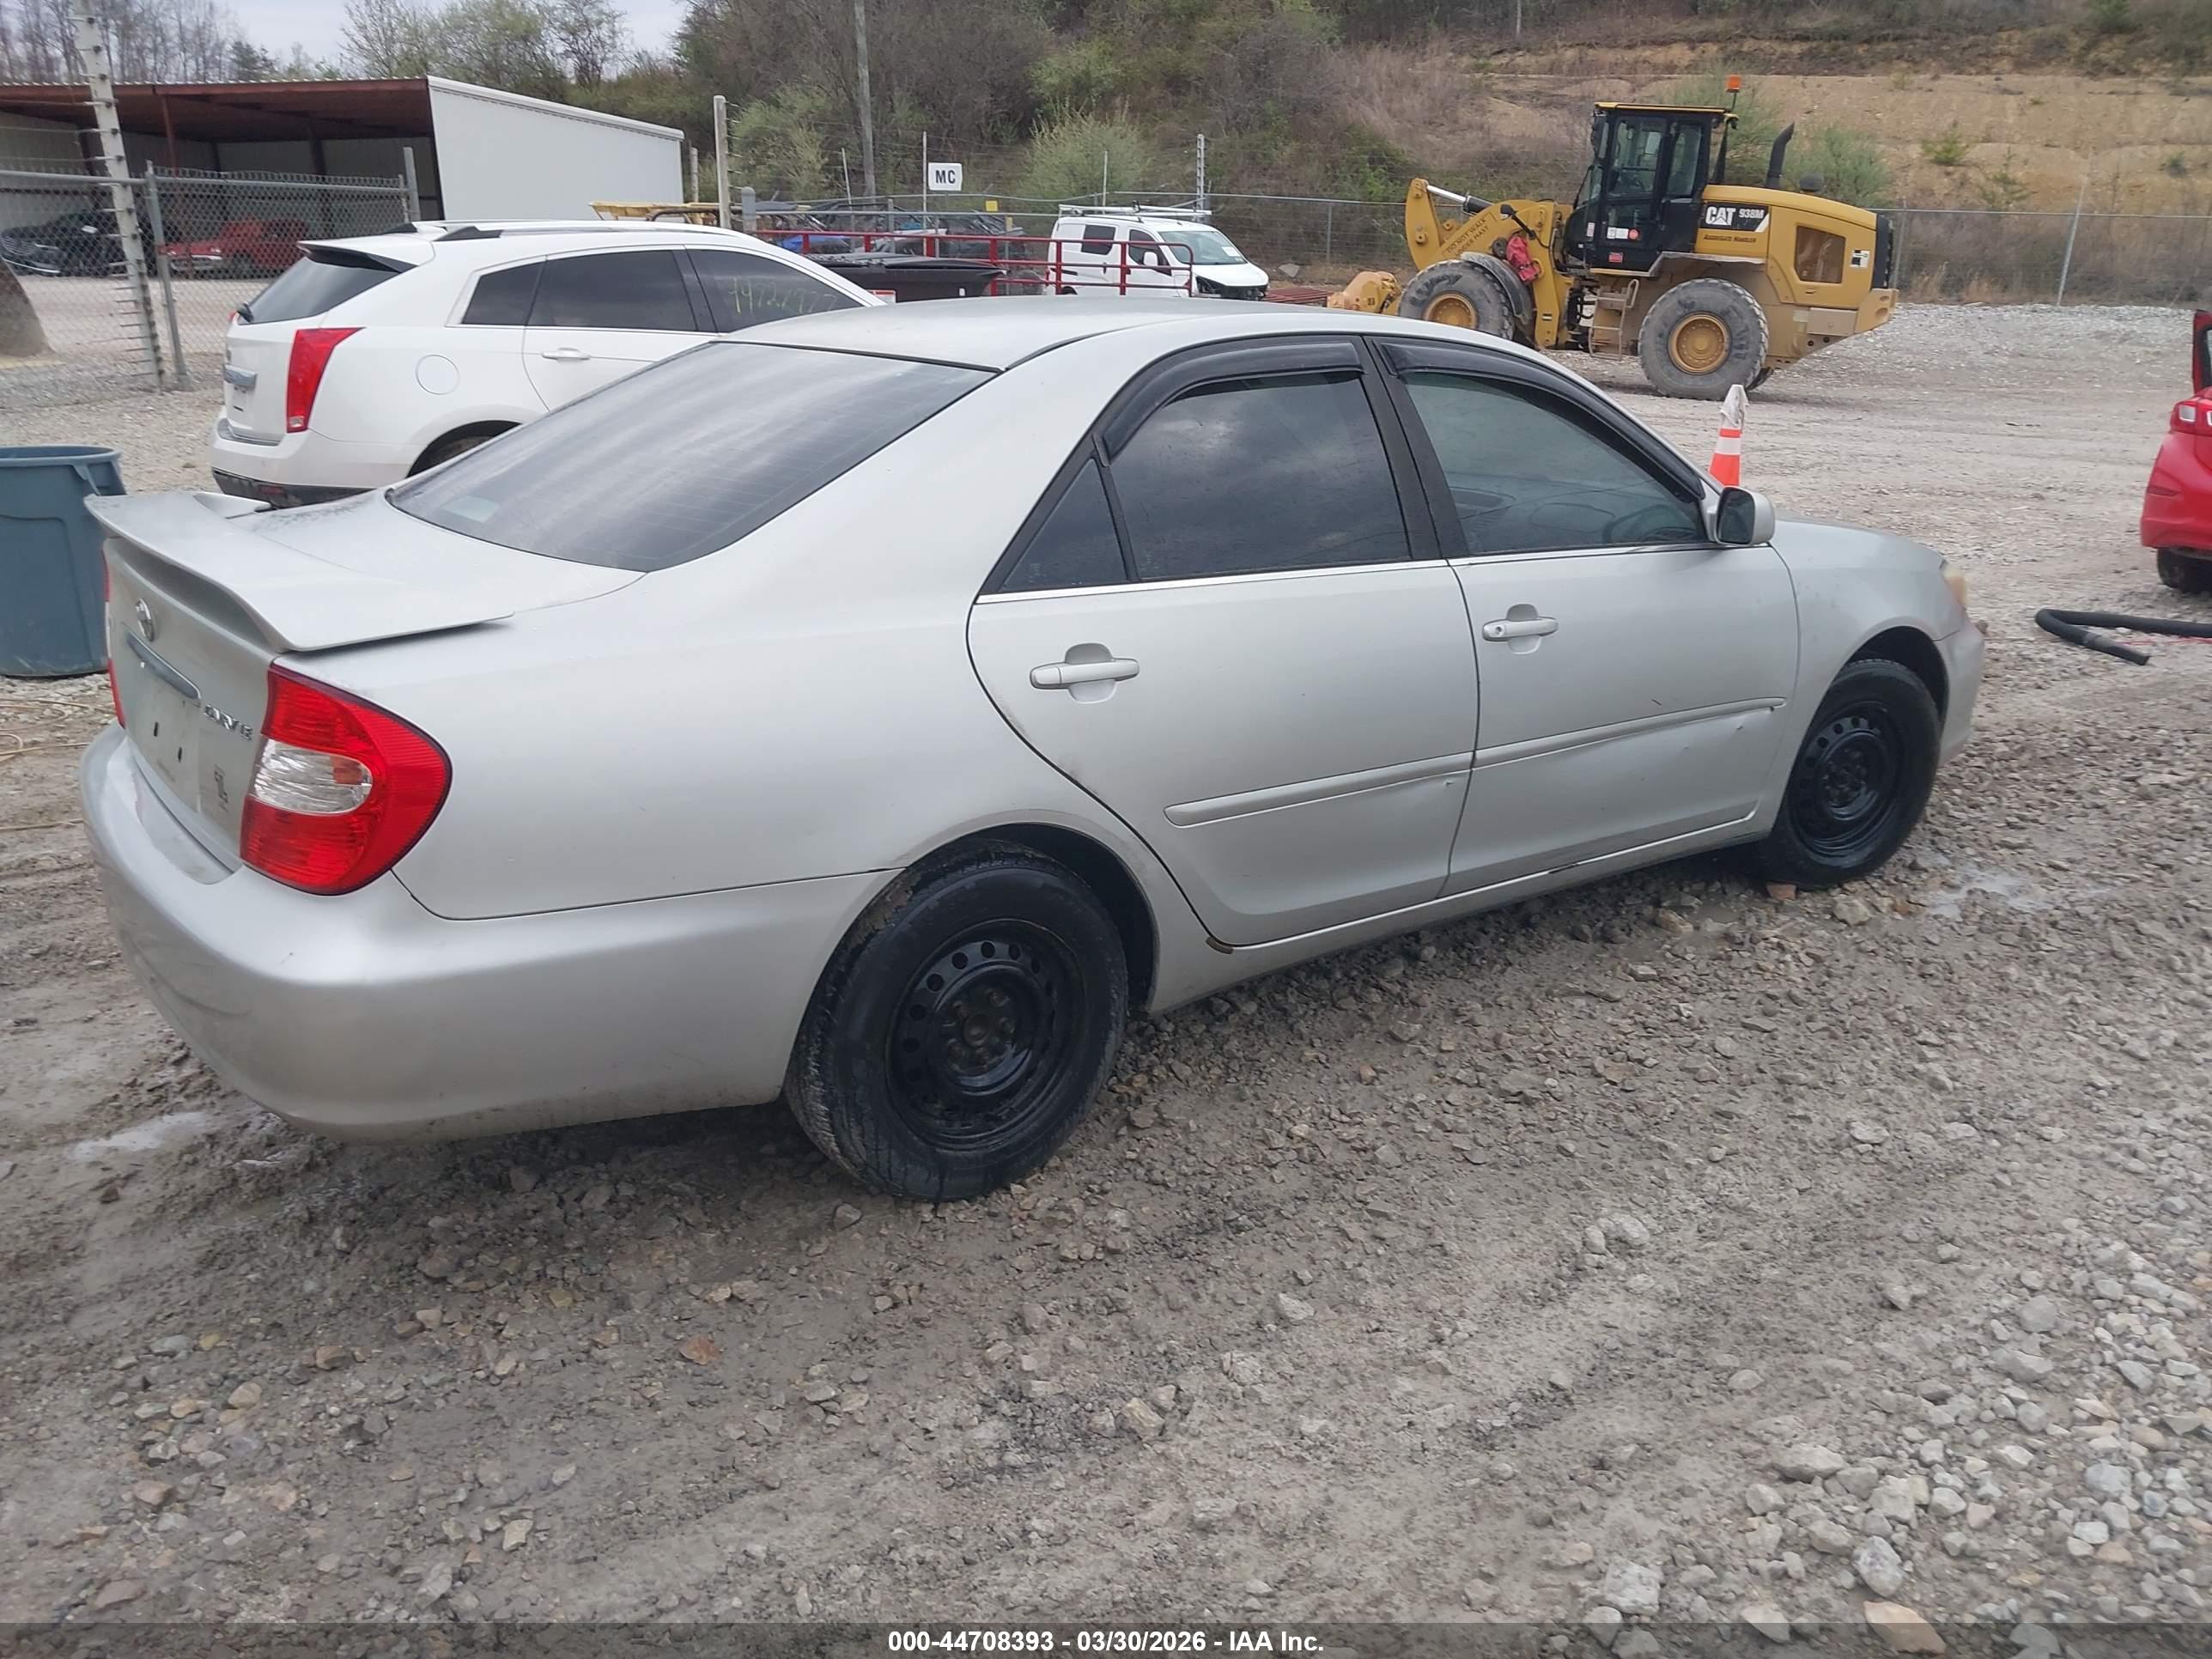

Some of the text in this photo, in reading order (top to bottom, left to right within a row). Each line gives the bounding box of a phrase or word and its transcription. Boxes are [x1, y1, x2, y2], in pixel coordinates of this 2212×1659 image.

[935, 169, 956, 184] MC
[1705, 206, 1765, 226] CAT 938M
